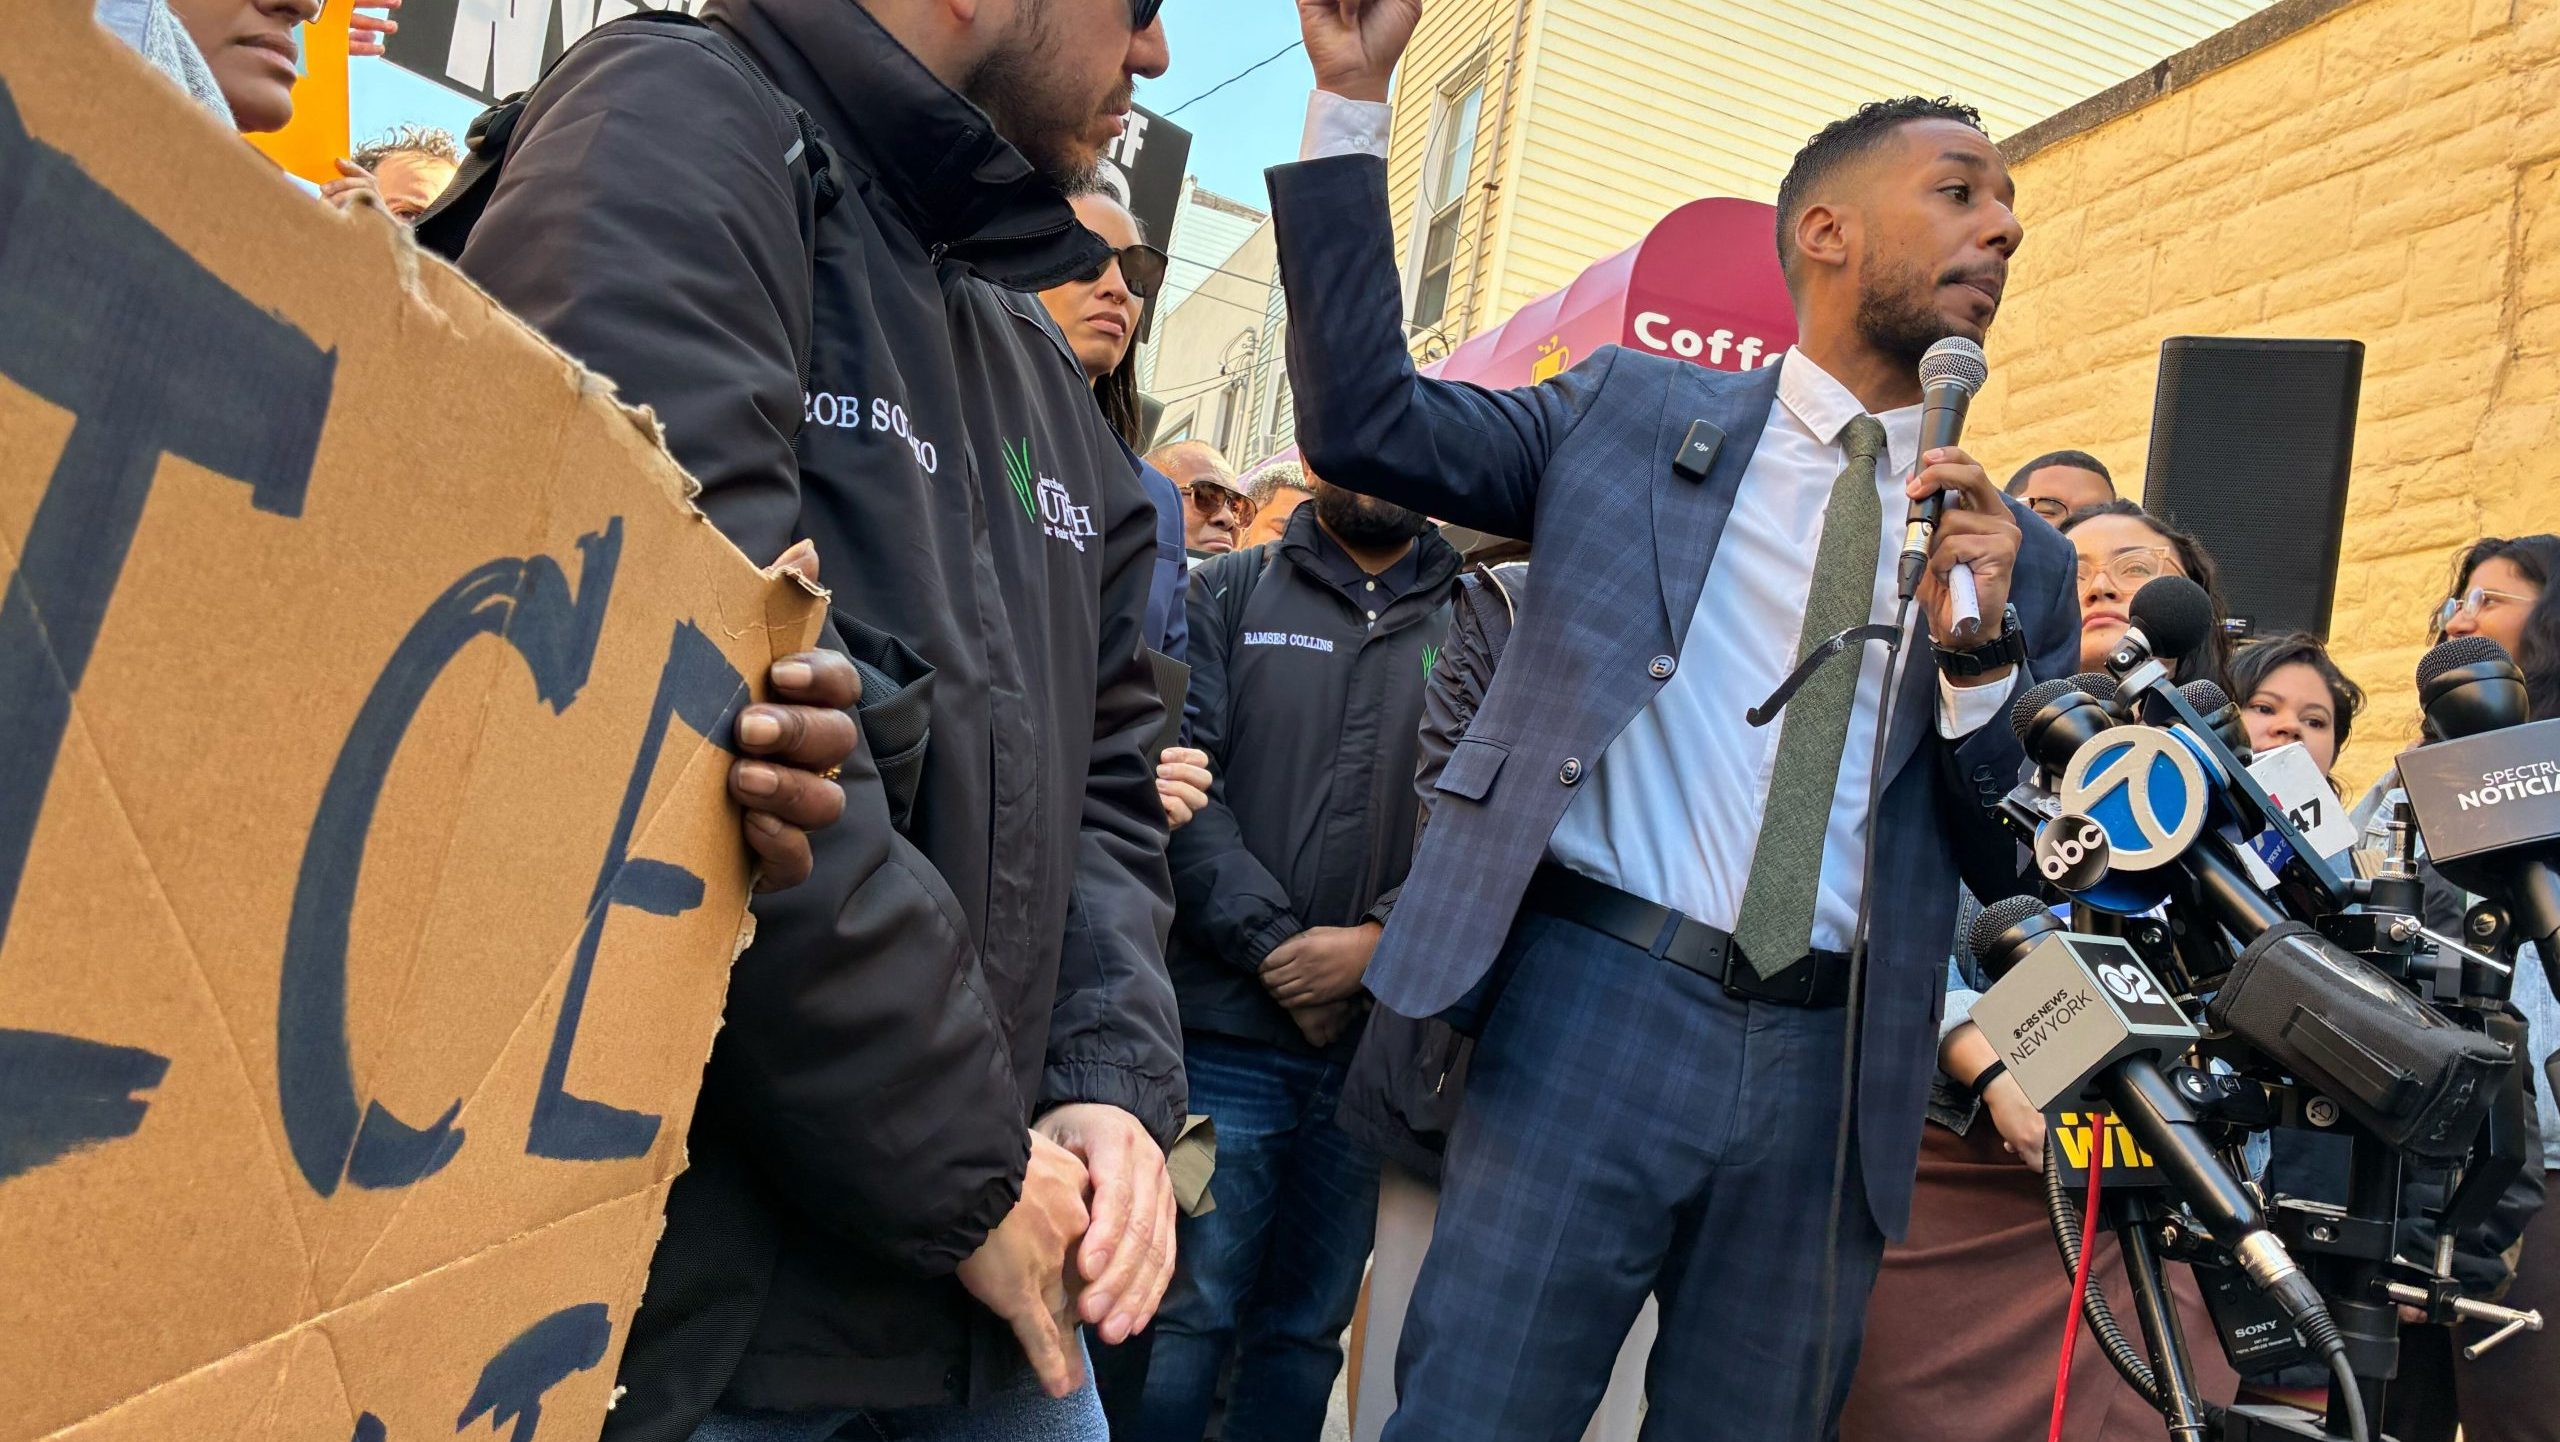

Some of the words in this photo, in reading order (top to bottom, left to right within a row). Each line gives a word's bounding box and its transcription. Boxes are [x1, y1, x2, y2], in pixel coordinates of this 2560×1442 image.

[1244, 631, 1287, 645] RAMSES
[1289, 633, 1334, 653] COLLINS
[2041, 824, 2103, 880] abc
[2010, 1025, 2049, 1066] NEW
[2045, 988, 2094, 1033] YORK
[2019, 1012, 2041, 1034] CBS
[2037, 988, 2069, 1019] NEWS
[2234, 1319, 2279, 1339] SONY
